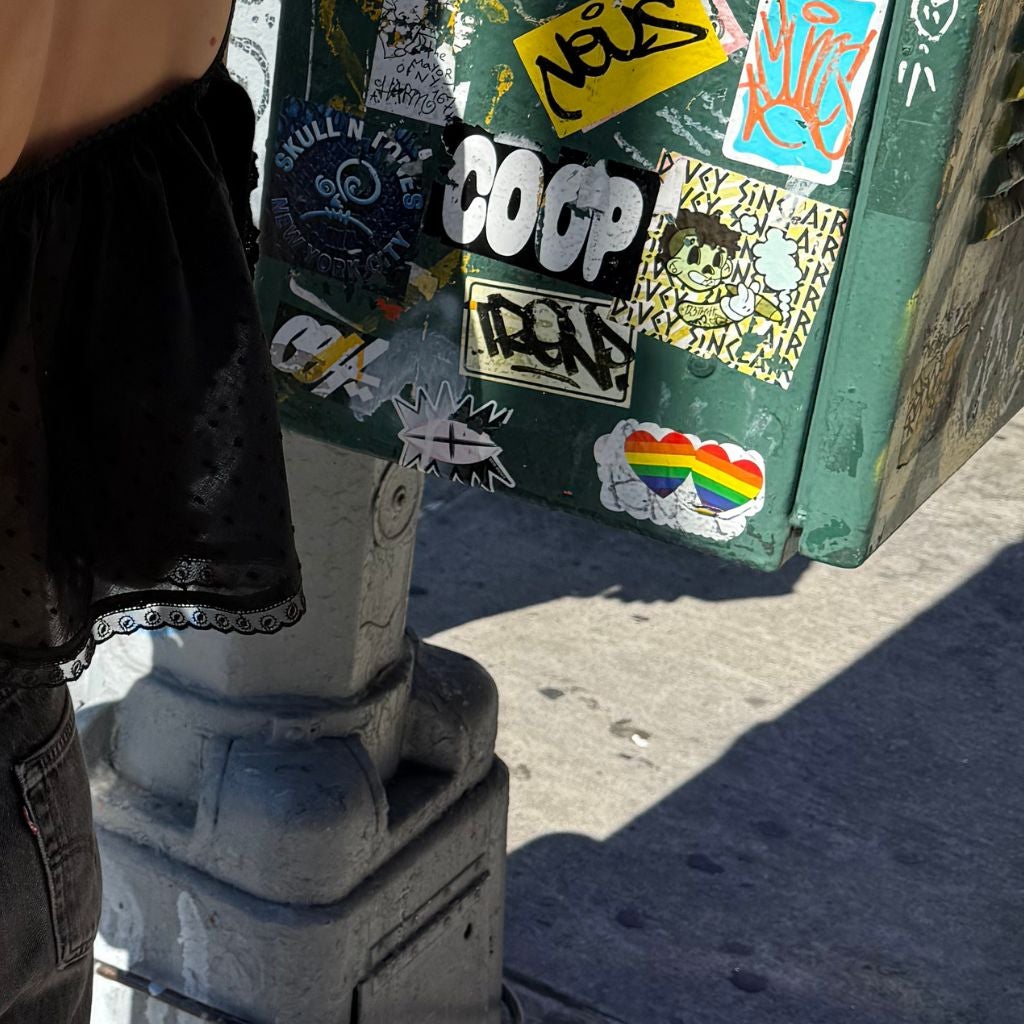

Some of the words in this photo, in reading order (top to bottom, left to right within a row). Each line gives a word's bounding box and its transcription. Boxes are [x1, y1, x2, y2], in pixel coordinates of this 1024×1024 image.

[275, 117, 341, 173] SKULL
[347, 117, 364, 141] N
[271, 197, 306, 248] NEW
[306, 242, 362, 277] YORK
